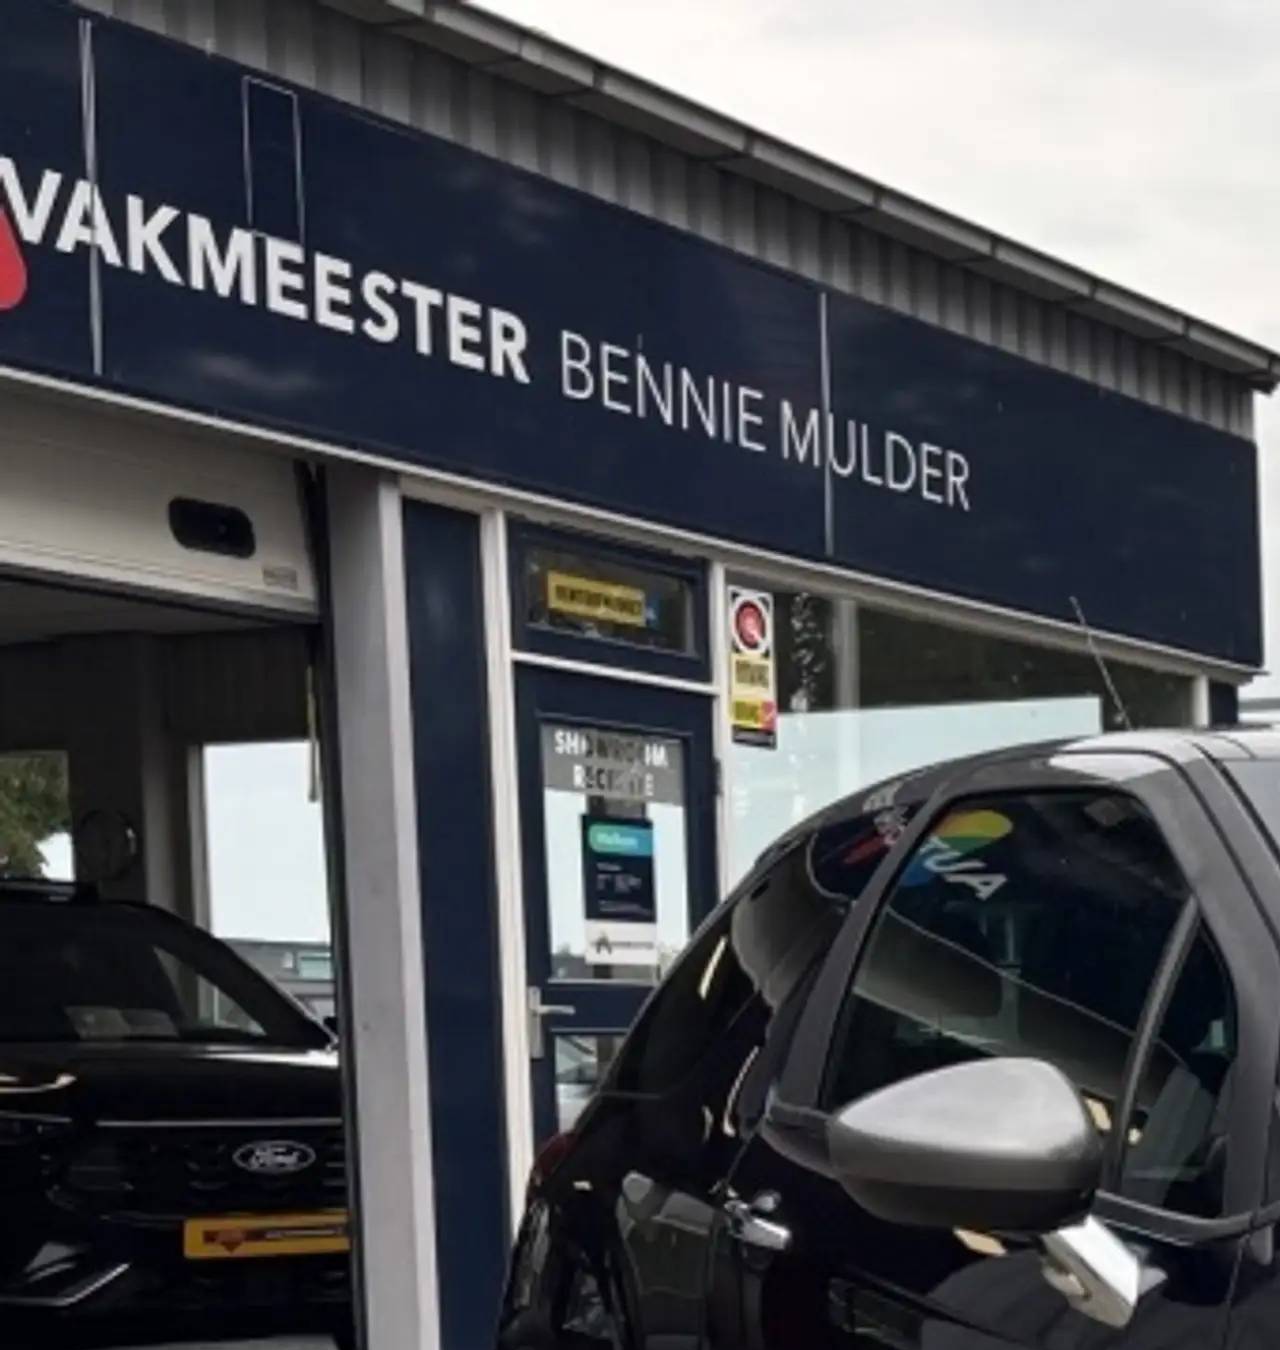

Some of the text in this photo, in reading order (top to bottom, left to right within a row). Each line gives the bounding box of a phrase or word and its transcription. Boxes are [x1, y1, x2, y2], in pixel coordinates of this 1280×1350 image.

[0, 155, 971, 511] VAKMEESTER BENNIE MULDER
